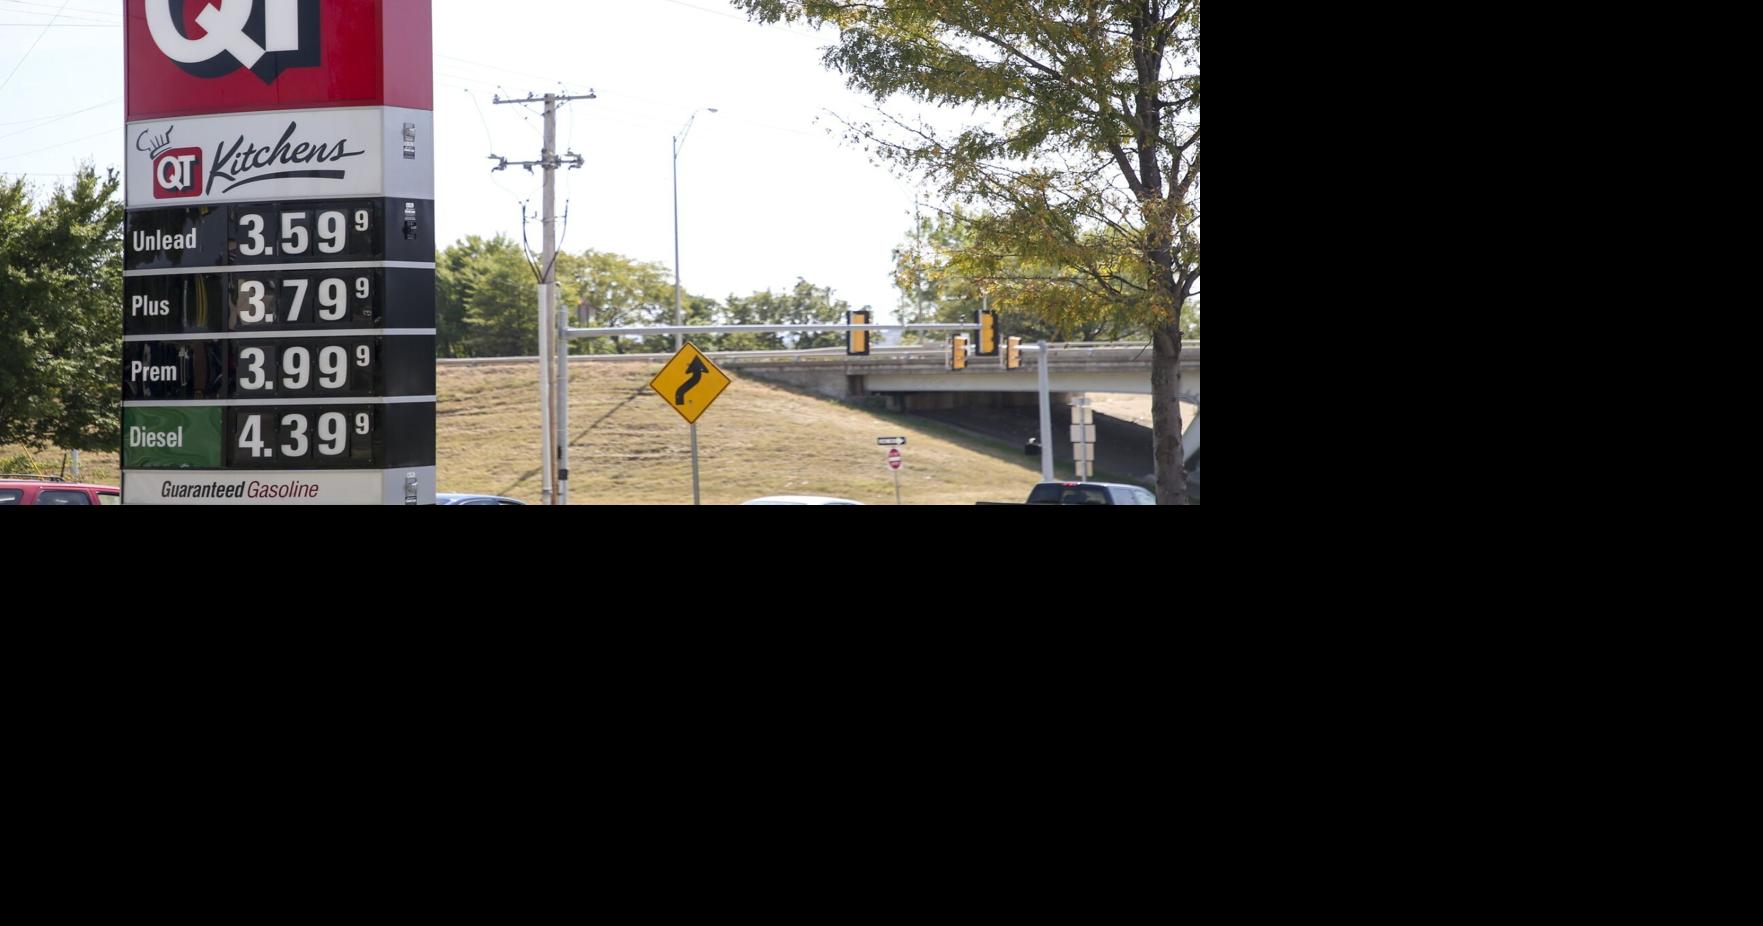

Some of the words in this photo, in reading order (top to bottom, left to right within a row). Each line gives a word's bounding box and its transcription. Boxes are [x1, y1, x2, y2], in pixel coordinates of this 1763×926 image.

[156, 154, 197, 191] QT
[205, 120, 366, 196] Kitchens
[132, 227, 198, 252] Unlead
[238, 210, 347, 256] 3.59
[131, 295, 171, 317] Plus
[239, 277, 348, 323] 3.79
[130, 361, 178, 382] Prem
[239, 345, 348, 391] 3.99
[128, 426, 184, 448] Diesel
[238, 411, 348, 458] 4.39
[160, 481, 246, 499] Guaranteed
[246, 481, 320, 499] Gasoline
